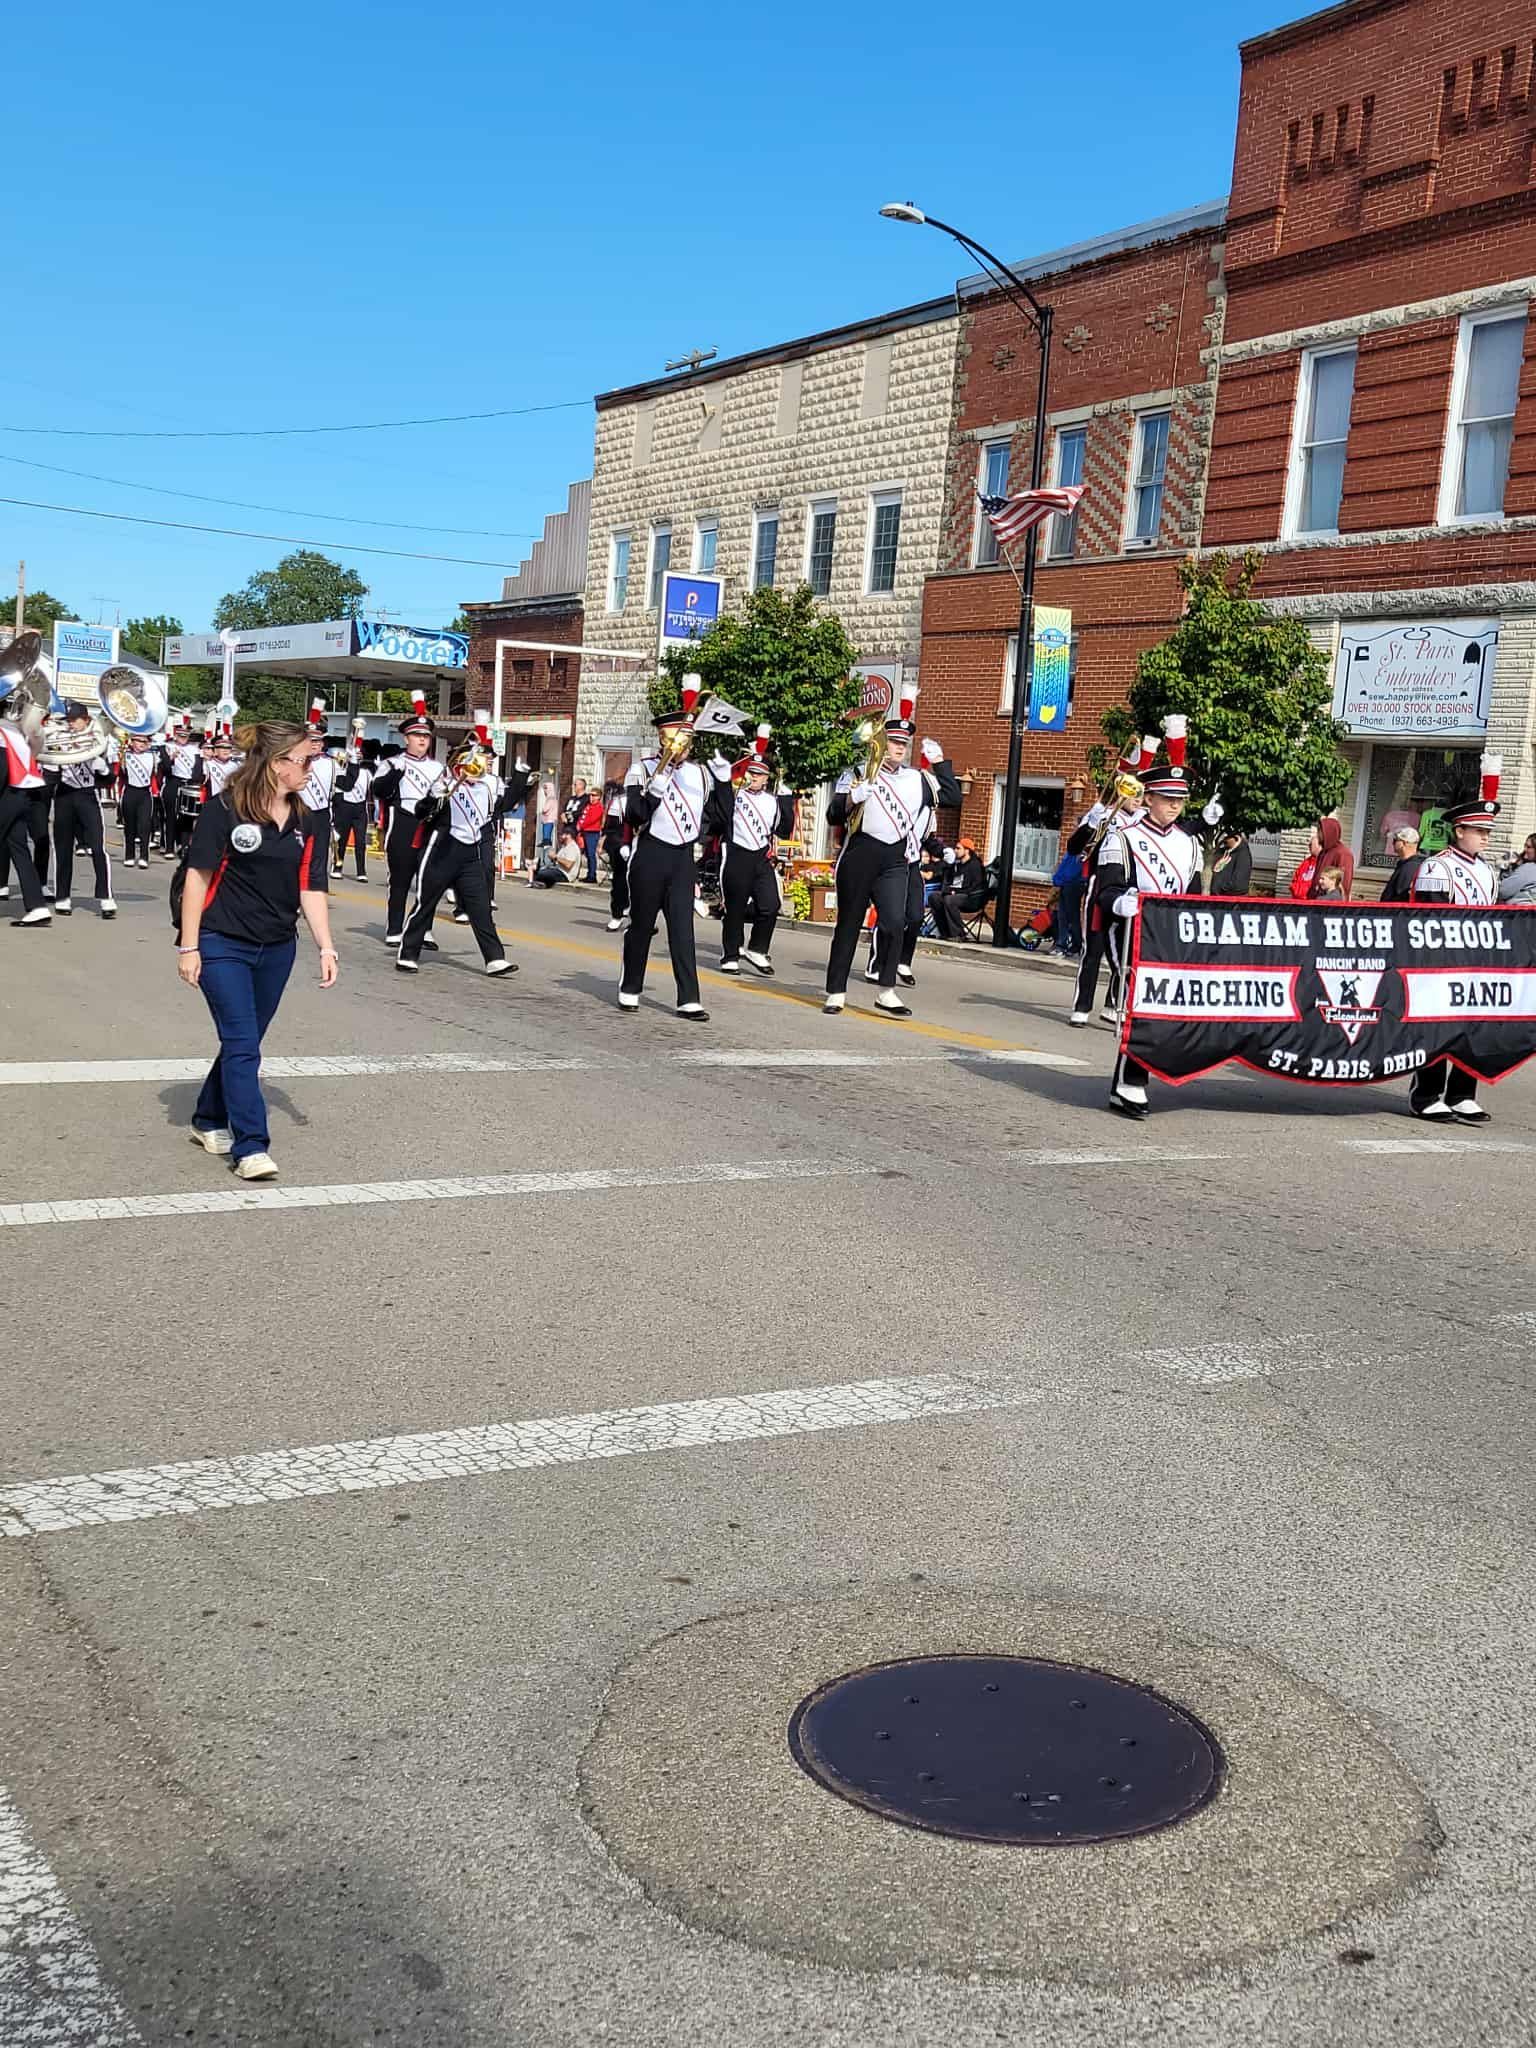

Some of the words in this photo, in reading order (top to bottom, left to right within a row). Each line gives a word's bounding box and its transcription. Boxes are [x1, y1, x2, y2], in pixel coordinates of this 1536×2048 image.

[64, 634, 107, 649] Wooten
[356, 614, 466, 669] Wooten
[1380, 640, 1406, 667] St.
[1415, 639, 1456, 660] Paris
[1374, 665, 1457, 689] Embroidery
[712, 712, 730, 724] G
[1347, 703, 1369, 713] OVER
[1404, 703, 1432, 714] STOCK
[1435, 703, 1474, 714] DESIGNS
[1359, 715, 1386, 726] Phone:
[1391, 716, 1413, 727] (937)
[1178, 911, 1310, 947] GRAHAM
[1323, 917, 1394, 949] HIGH
[1407, 919, 1512, 950] SCHOOL
[1315, 957, 1355, 970] DANCIN'
[1357, 958, 1386, 971] BAND
[1142, 977, 1285, 1008] MARCHING
[1448, 982, 1513, 1007] BAND
[1268, 1049, 1300, 1074] ST.
[1308, 1057, 1375, 1080] PARIS,
[1383, 1049, 1427, 1075] OHIO
